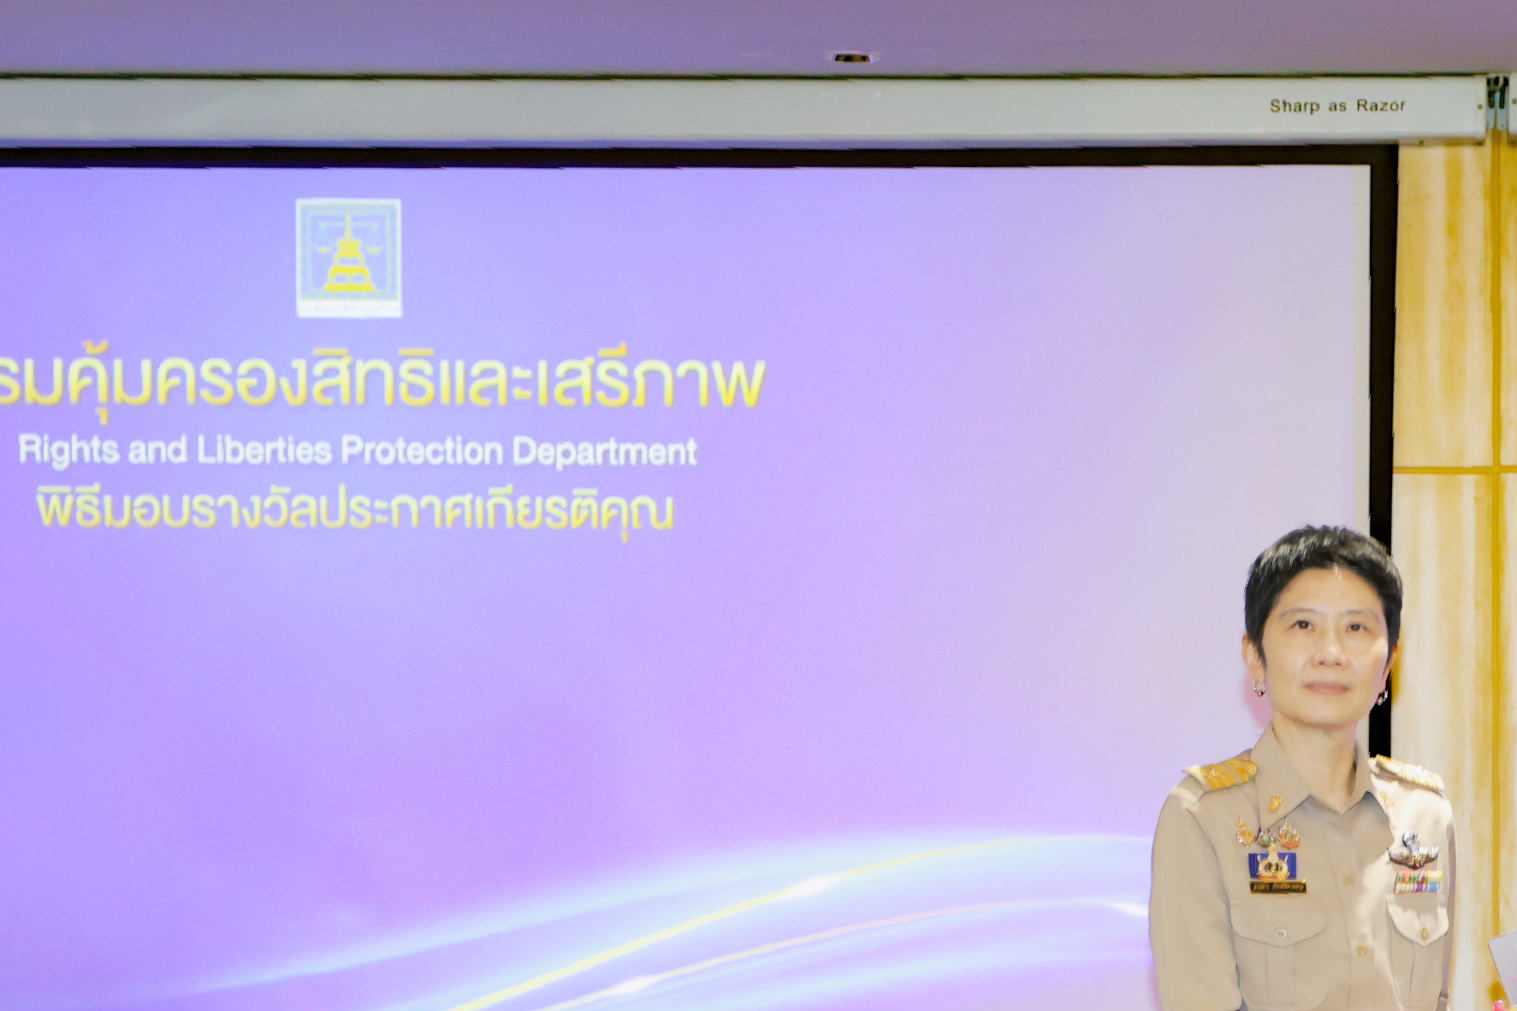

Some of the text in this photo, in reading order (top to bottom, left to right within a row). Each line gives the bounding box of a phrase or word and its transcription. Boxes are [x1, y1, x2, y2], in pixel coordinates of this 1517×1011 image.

[1270, 98, 1406, 116] Sharp as Razor
[18, 433, 698, 471] Rights and Liberties Protection Department
[36, 483, 674, 542] พิธีมอบรางวัลประกาศเกียรติคุณ
